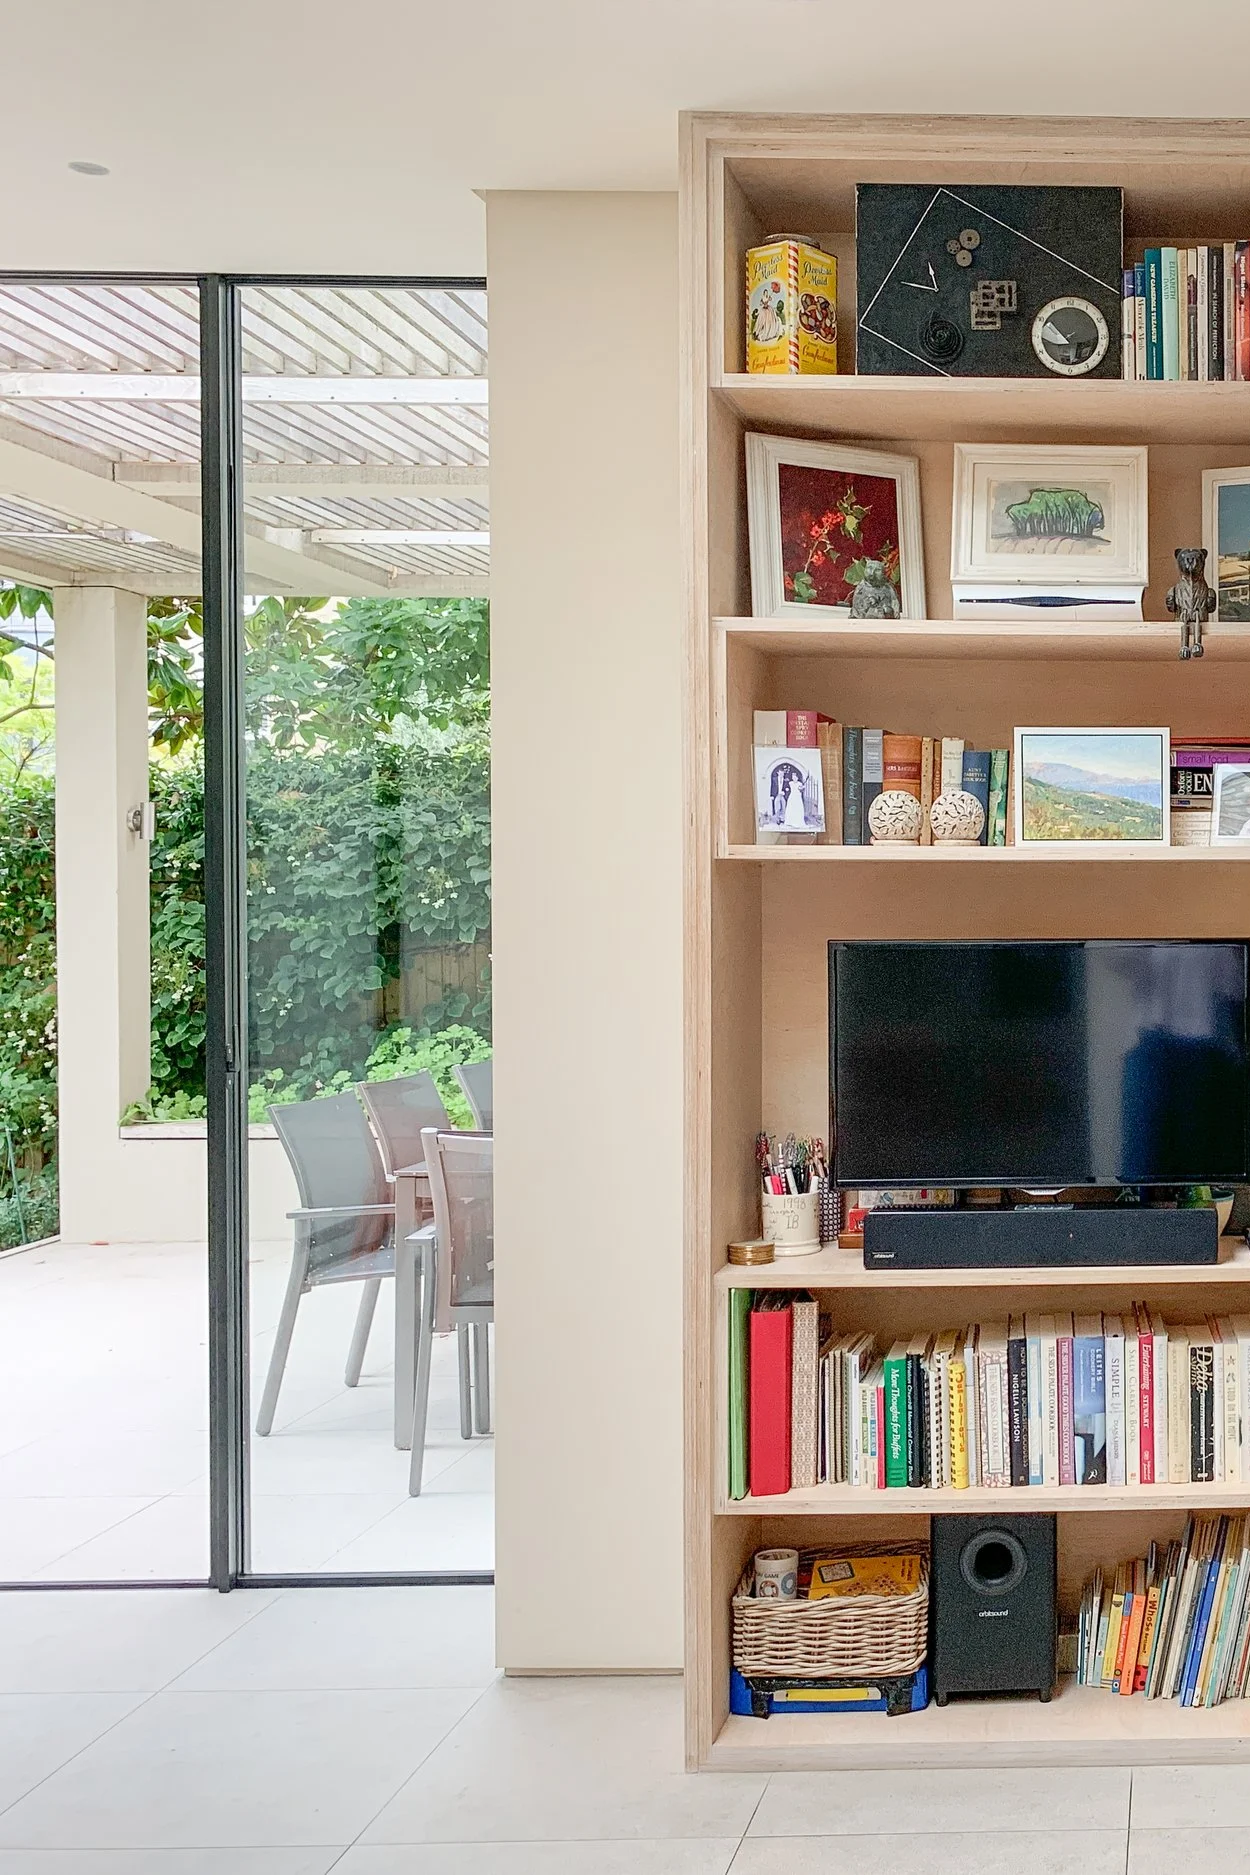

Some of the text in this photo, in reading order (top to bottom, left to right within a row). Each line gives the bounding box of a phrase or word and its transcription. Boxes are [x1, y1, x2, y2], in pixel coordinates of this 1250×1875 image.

[753, 254, 783, 281] Peerless
[761, 265, 778, 281] Maid
[808, 276, 828, 286] Maid
[1137, 299, 1145, 331] Memorable
[1212, 321, 1218, 329] OF
[847, 730, 858, 800] Thoughts for Food
[1182, 754, 1229, 764] small food
[1177, 770, 1185, 796] Oxford
[783, 1198, 807, 1210] 1998
[1020, 1367, 1026, 1377] TO
[1111, 1358, 1120, 1398] SIMPLE
[1141, 1344, 1152, 1390] Entertaining
[1196, 1348, 1214, 1392] Delia
[1020, 1379, 1026, 1387] BE
[1129, 1350, 1137, 1443] SALLY CLARKE'S BOOK
[889, 1367, 900, 1459] More Thoughts for Buffets
[1012, 1373, 1021, 1442] NIGELLA LAWSON
